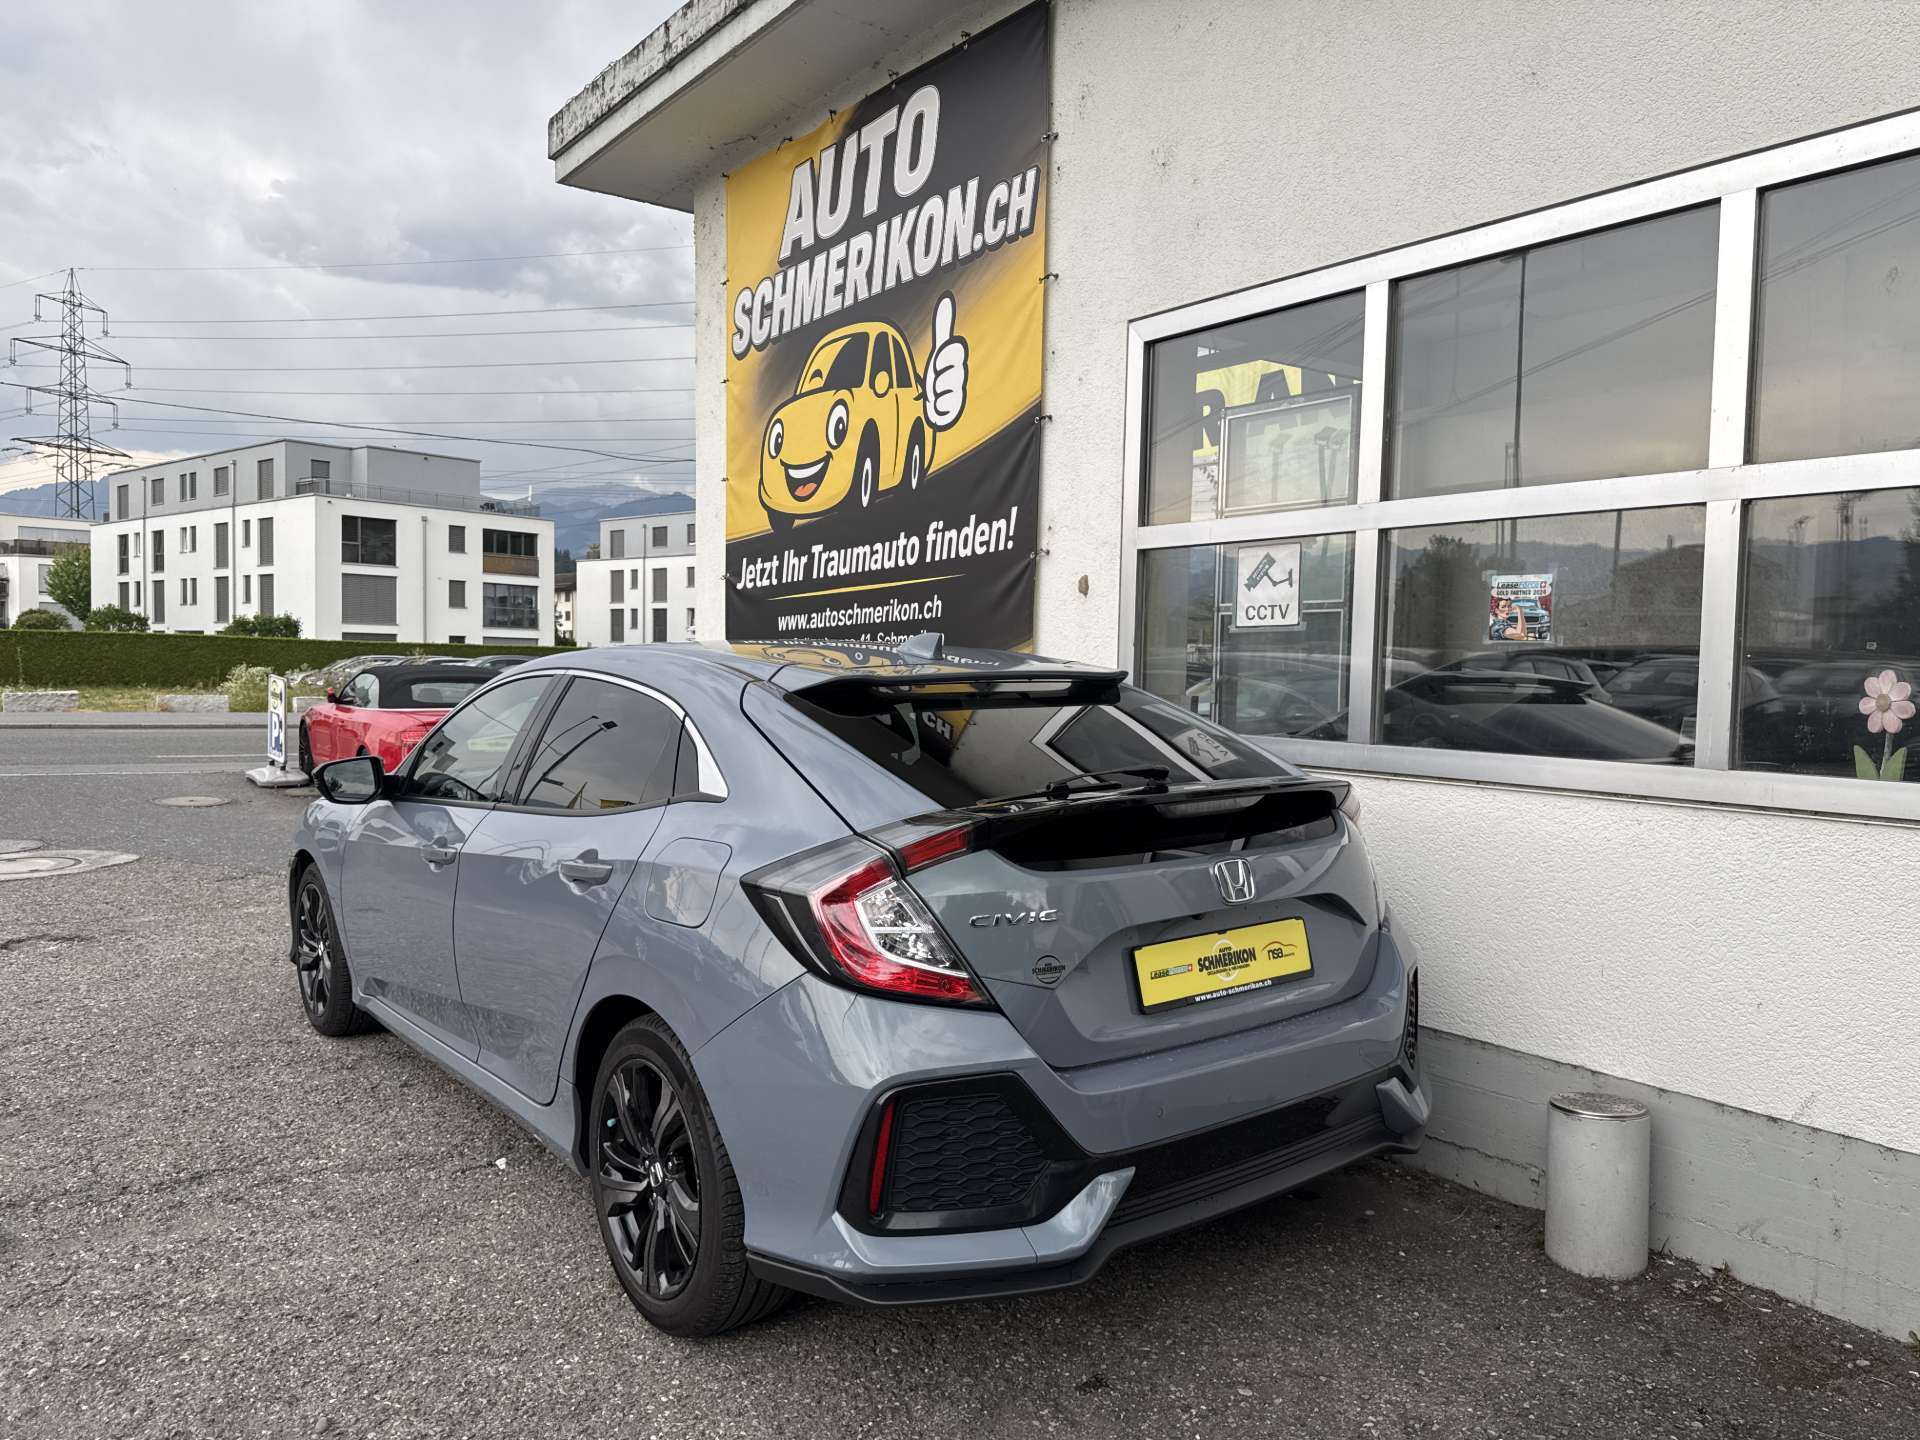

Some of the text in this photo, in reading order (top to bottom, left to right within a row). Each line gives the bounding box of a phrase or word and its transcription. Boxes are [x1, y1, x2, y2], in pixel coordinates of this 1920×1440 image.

[780, 85, 941, 262] AUTO
[731, 167, 1040, 357] SCHMERIKON.CH
[736, 506, 1018, 590] Jetzt Ihr Traumauto finden!
[778, 594, 942, 632] www.autoschmerikon.ch
[1245, 603, 1290, 621] CCTV
[969, 908, 1058, 928] CIVIC
[1197, 947, 1257, 973] SCHMERIKON
